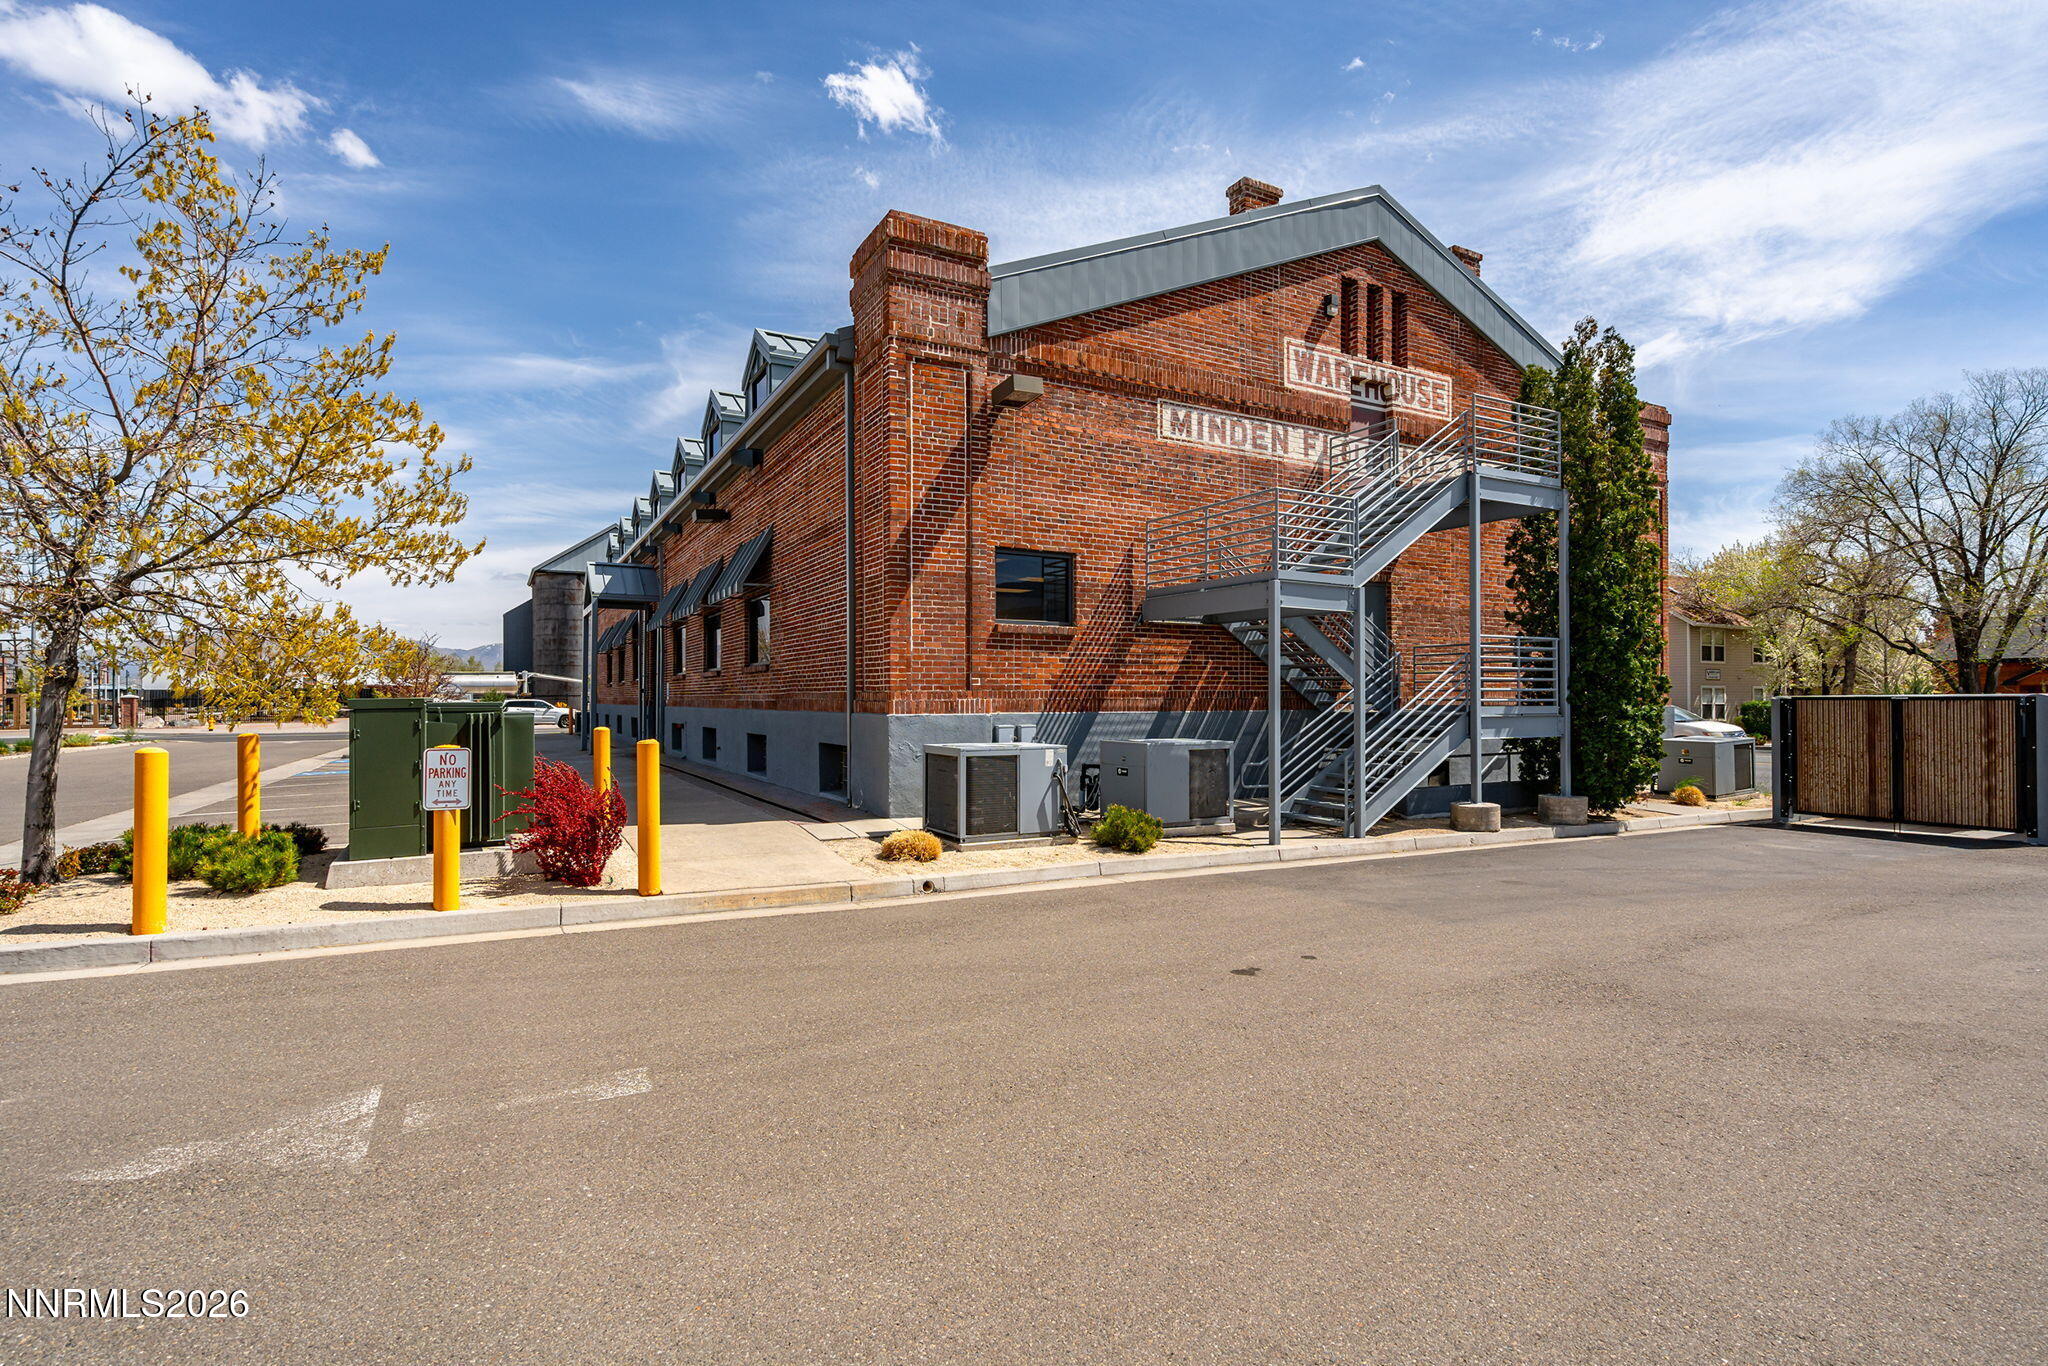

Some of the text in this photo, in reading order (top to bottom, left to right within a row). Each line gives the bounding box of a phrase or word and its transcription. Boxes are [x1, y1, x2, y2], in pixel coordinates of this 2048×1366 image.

[1293, 348, 1447, 411] WAREHOUSE
[1170, 407, 1289, 455] MINDEN
[440, 754, 457, 766] NO
[428, 767, 467, 778] PARKING
[438, 780, 457, 788] ANY
[436, 789, 458, 797] TIME
